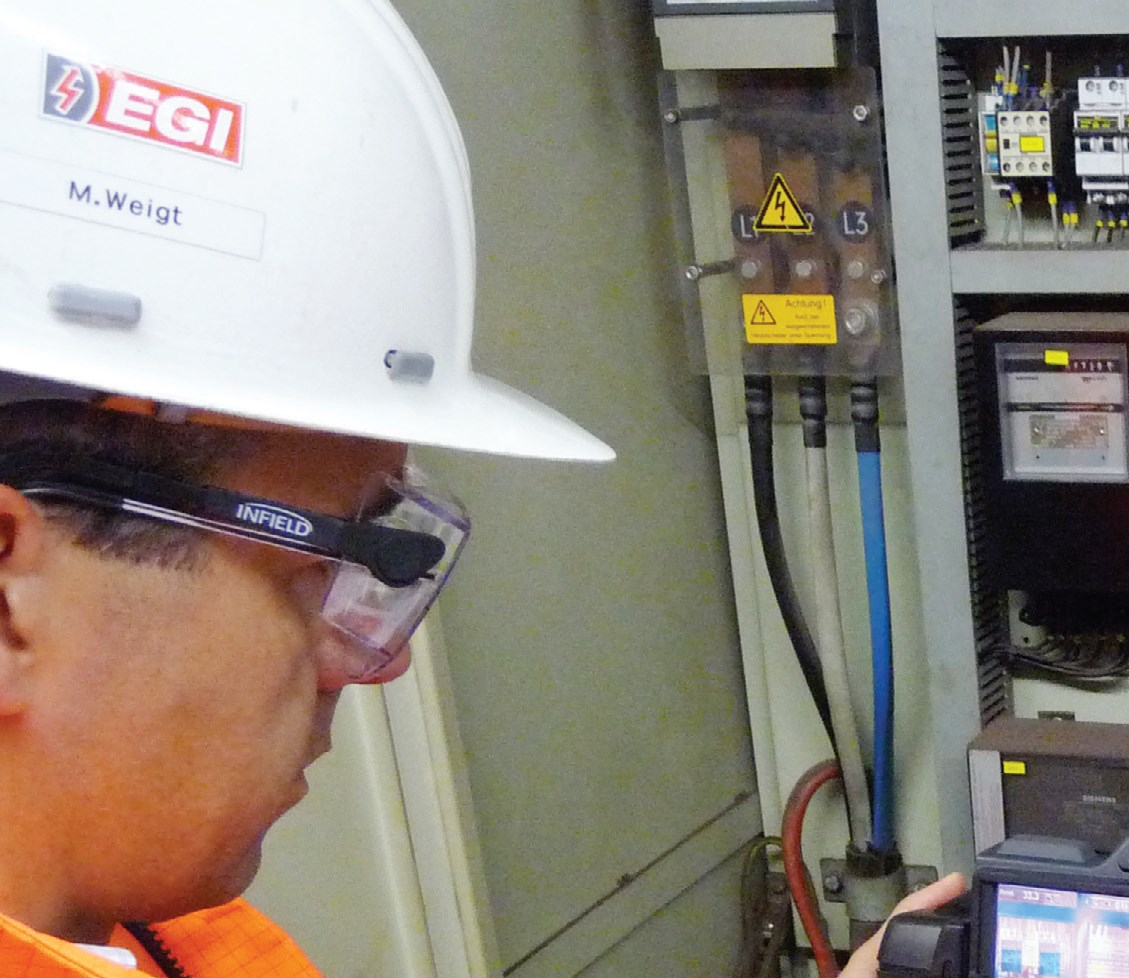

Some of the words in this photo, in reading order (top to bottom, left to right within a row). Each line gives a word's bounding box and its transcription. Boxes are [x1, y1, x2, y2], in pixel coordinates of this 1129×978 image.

[105, 80, 234, 152] EGI
[69, 181, 182, 225] M.Weigt
[843, 211, 868, 235] L3
[236, 504, 311, 536] INFIELD
